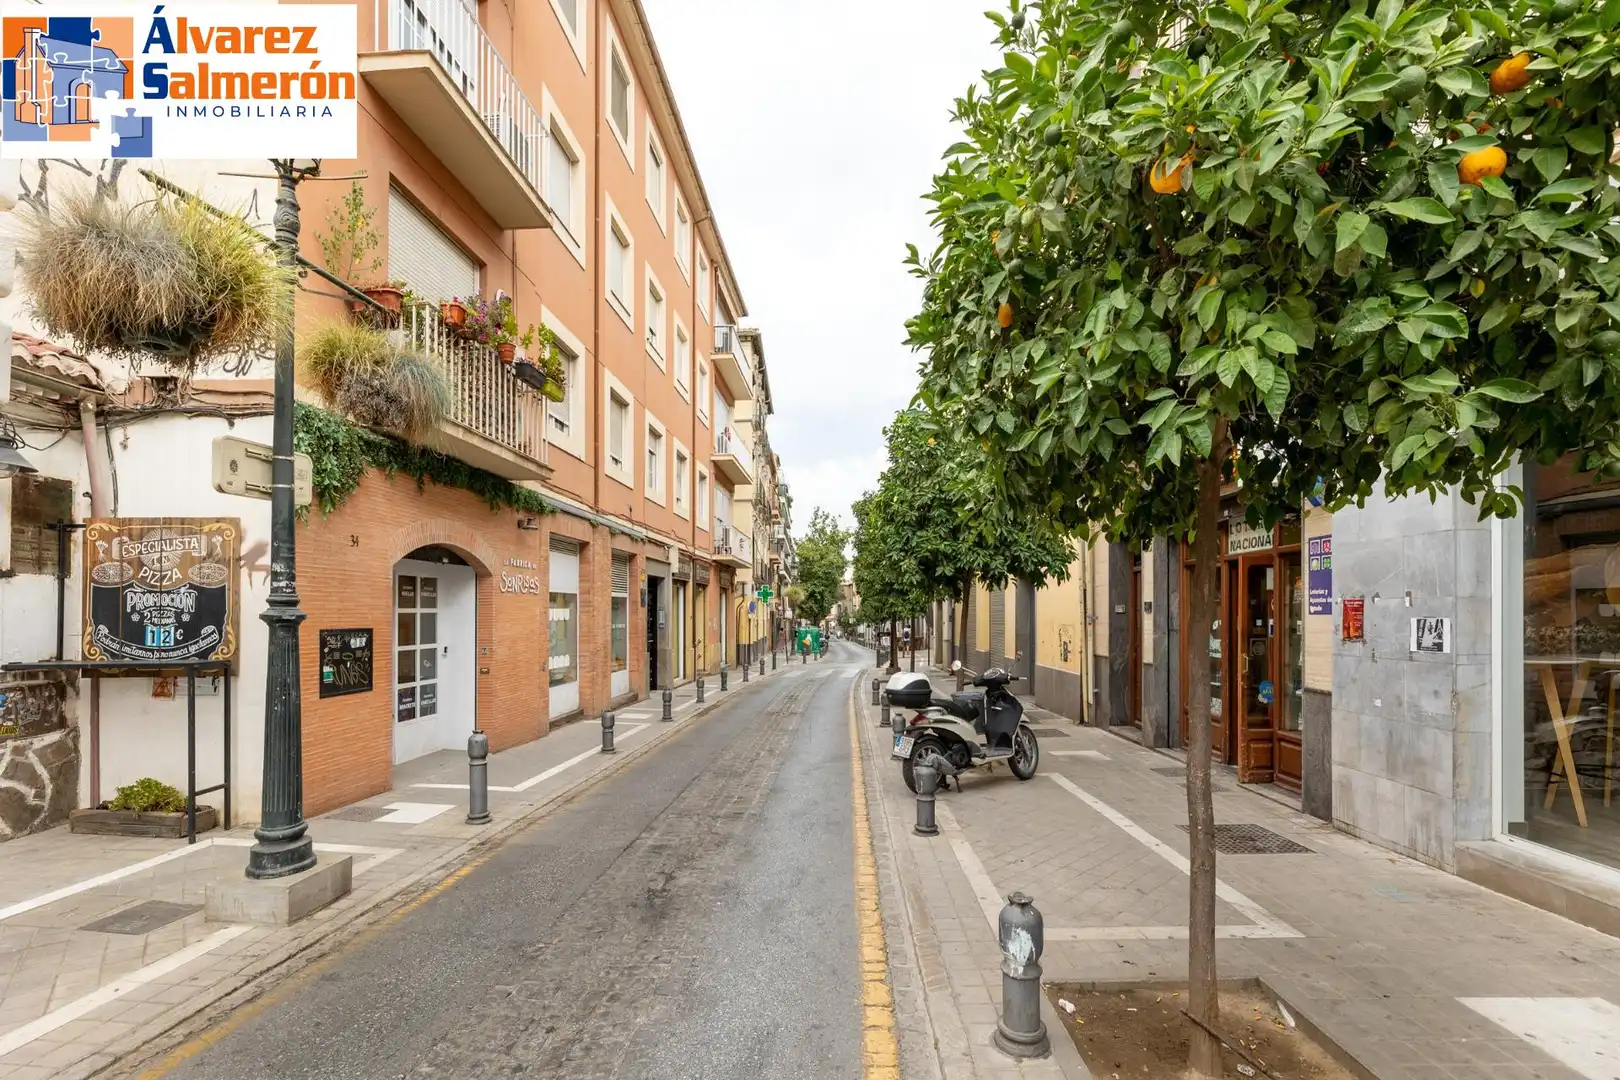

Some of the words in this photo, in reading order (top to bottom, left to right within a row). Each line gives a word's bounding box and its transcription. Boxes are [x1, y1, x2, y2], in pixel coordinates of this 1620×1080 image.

[122, 538, 199, 557] ESPECIALISTA
[350, 534, 359, 547] 34
[1230, 535, 1272, 552] NACIONA
[138, 566, 182, 585] PIZZA
[144, 612, 151, 623] 2
